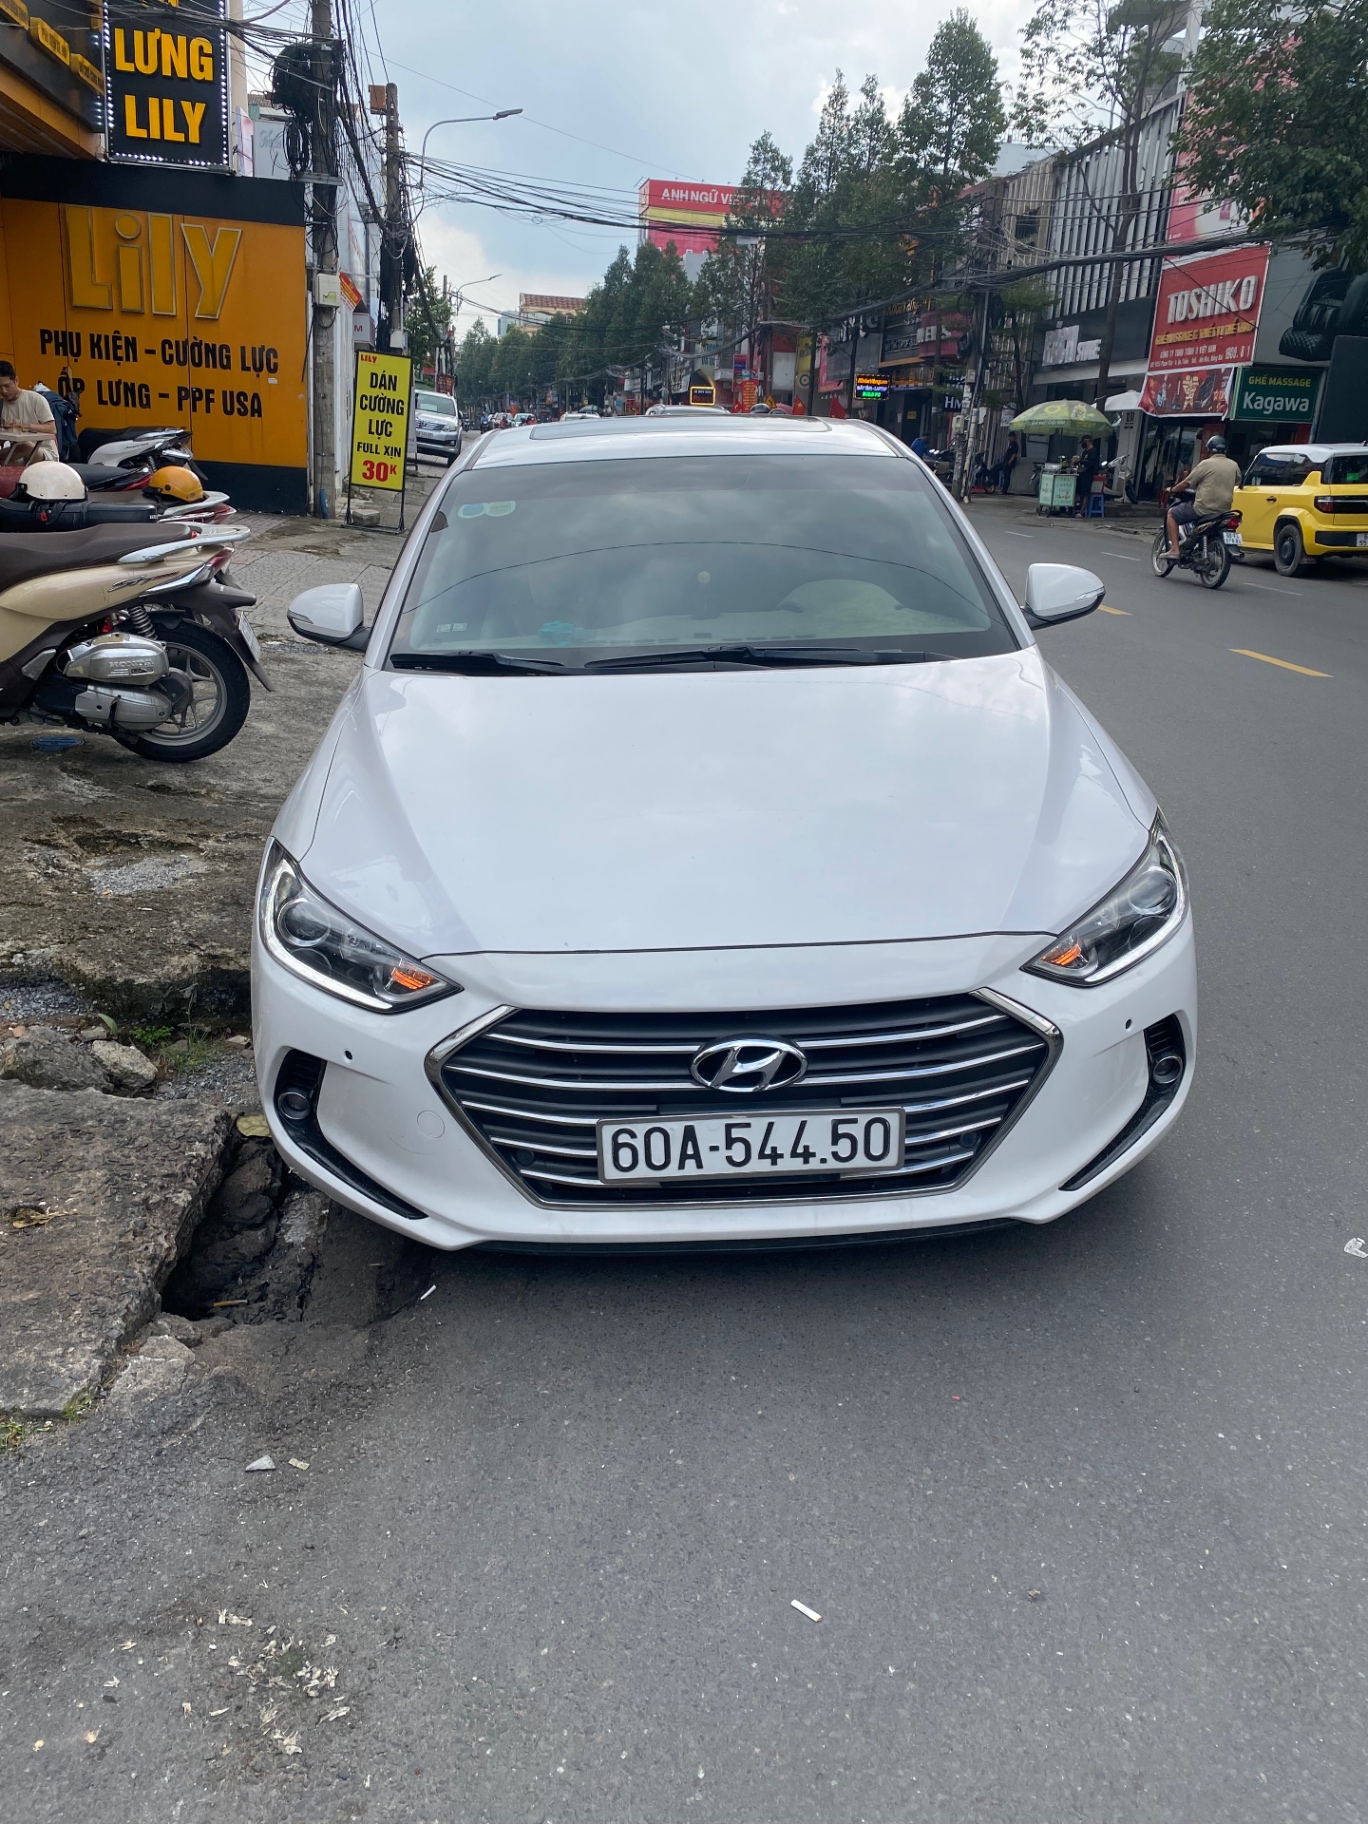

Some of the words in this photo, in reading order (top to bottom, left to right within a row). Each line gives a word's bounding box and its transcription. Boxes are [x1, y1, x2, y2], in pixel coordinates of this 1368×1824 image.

[115, 27, 213, 81] LƯNG
[124, 94, 206, 144] LILY
[661, 188, 689, 202] ANH
[690, 189, 718, 204] NGỮ
[1167, 275, 1258, 323] TOSHIKO
[40, 329, 82, 363] PHỤ
[89, 330, 138, 366] KIỆN
[160, 336, 232, 371] CƯỜNG
[240, 344, 279, 378] LỰC
[360, 353, 377, 364] LILY
[369, 369, 398, 392] DÁN
[1248, 373, 1267, 385] GHẾ
[1268, 377, 1312, 387] MASSAGE
[96, 378, 151, 409] LƯNG
[177, 385, 215, 414] PPF
[222, 389, 262, 418] USA
[359, 392, 404, 416] CƯỜNG
[1243, 391, 1310, 415] Kagawa
[368, 418, 393, 440] LỰC
[356, 441, 380, 455] FULL
[383, 444, 401, 459] XỊN
[109, 660, 154, 668] HONDA
[611, 1116, 891, 1173] 60A-544.50
